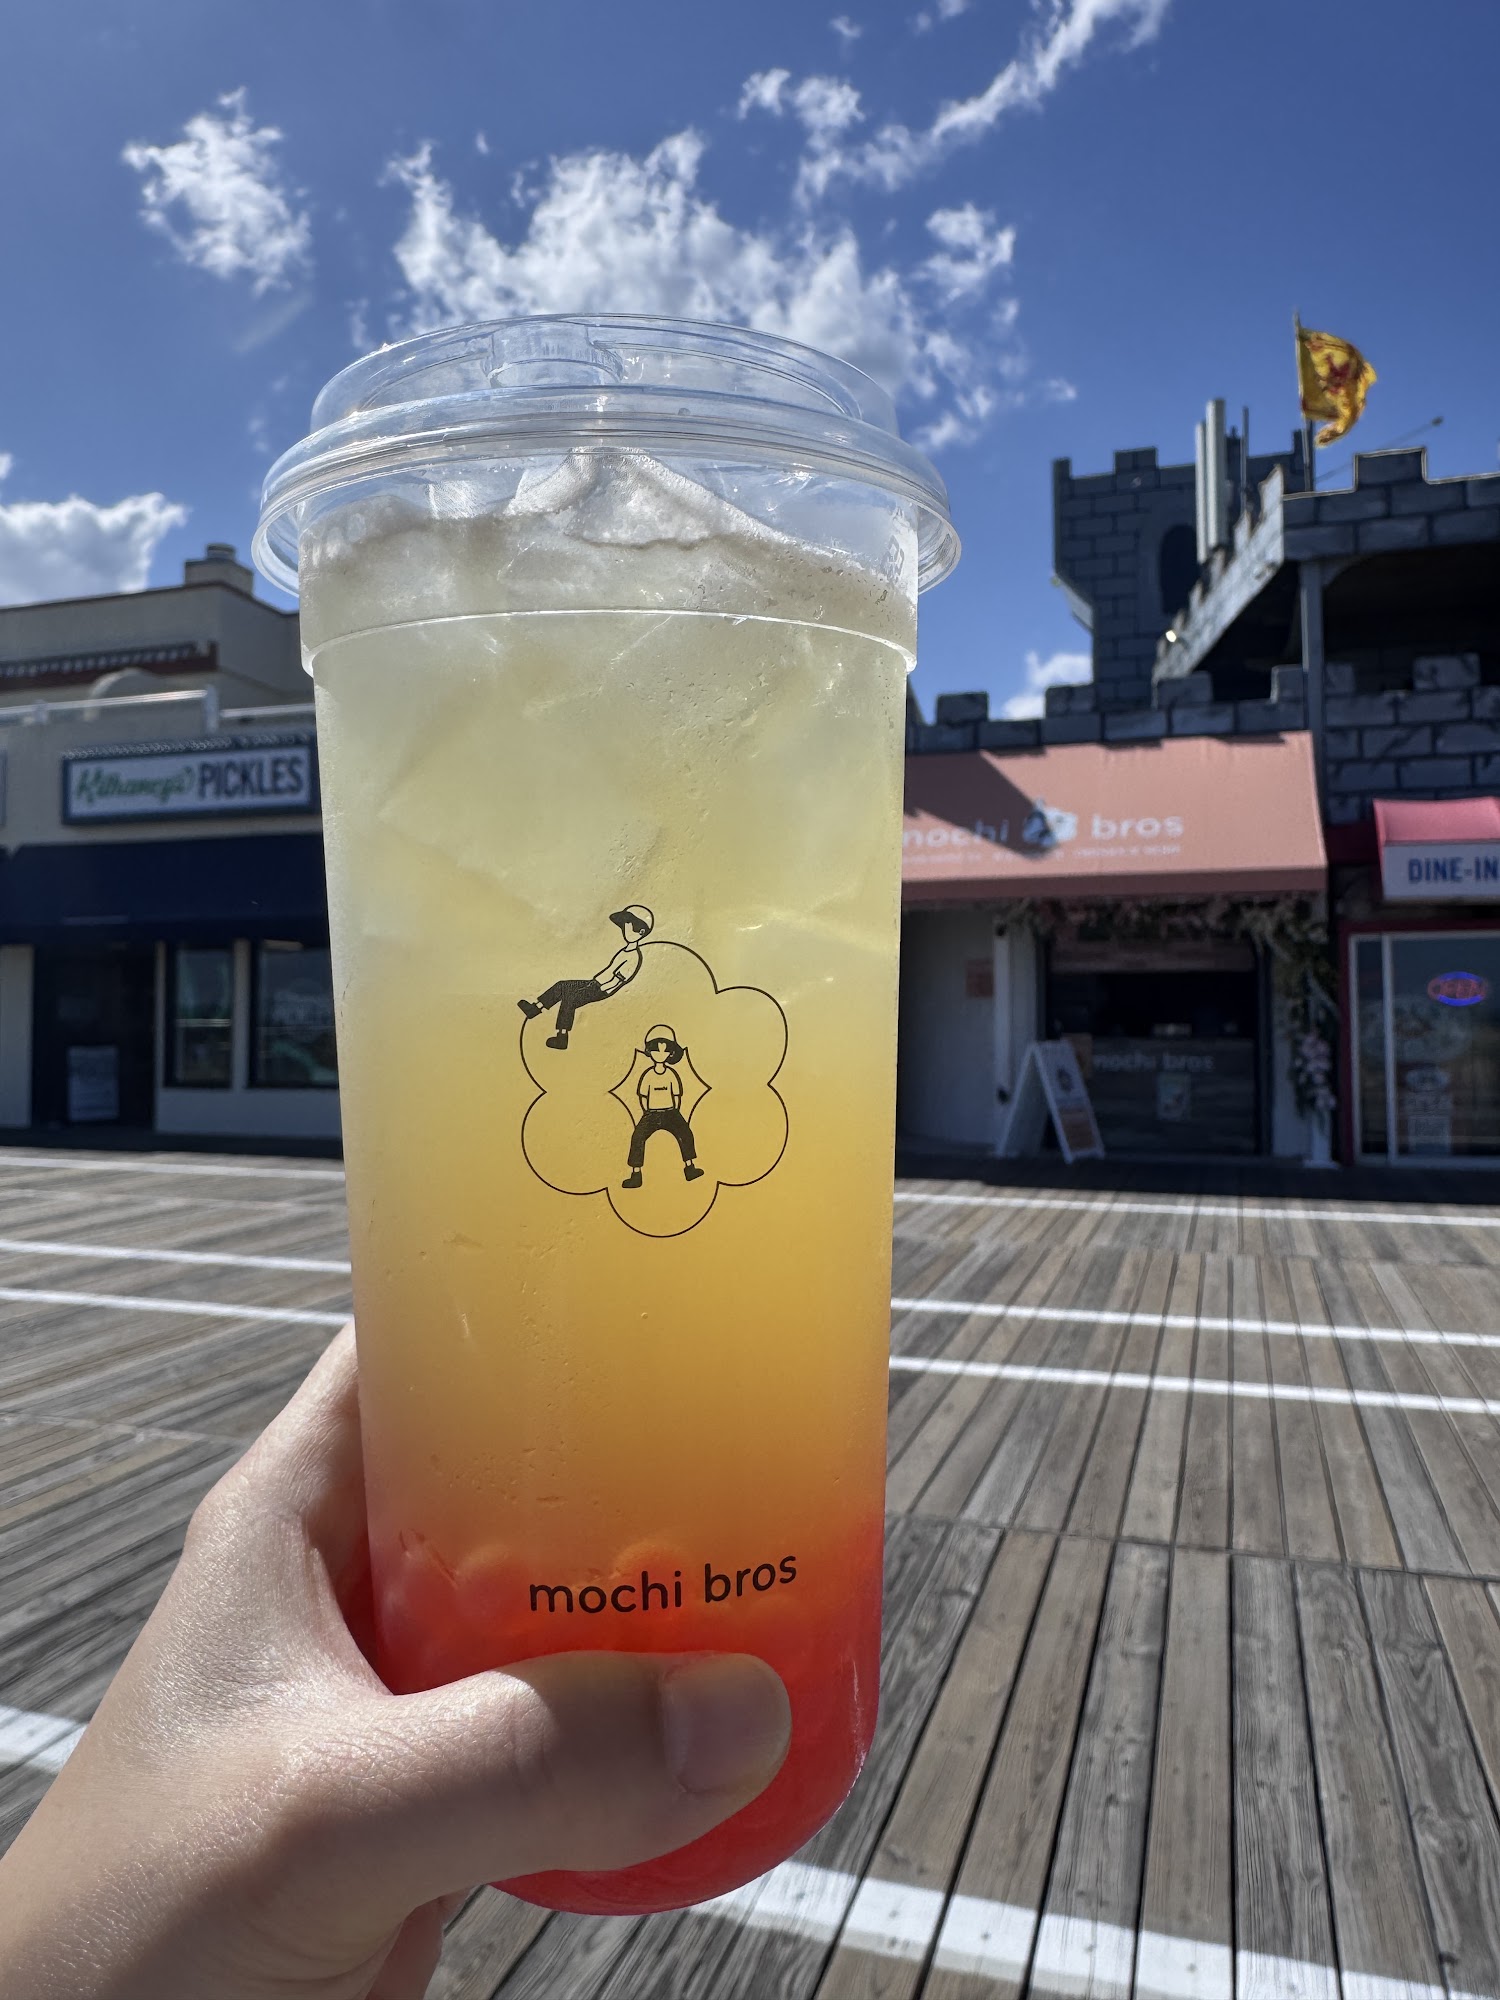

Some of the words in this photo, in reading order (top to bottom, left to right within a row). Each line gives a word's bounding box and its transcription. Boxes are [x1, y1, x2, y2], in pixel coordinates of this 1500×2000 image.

[200, 755, 304, 800] PICKLES
[1091, 814, 1184, 840] bros
[1408, 855, 1499, 884] DINE-IN
[529, 1570, 683, 1613] mochi
[704, 1555, 797, 1604] bros
